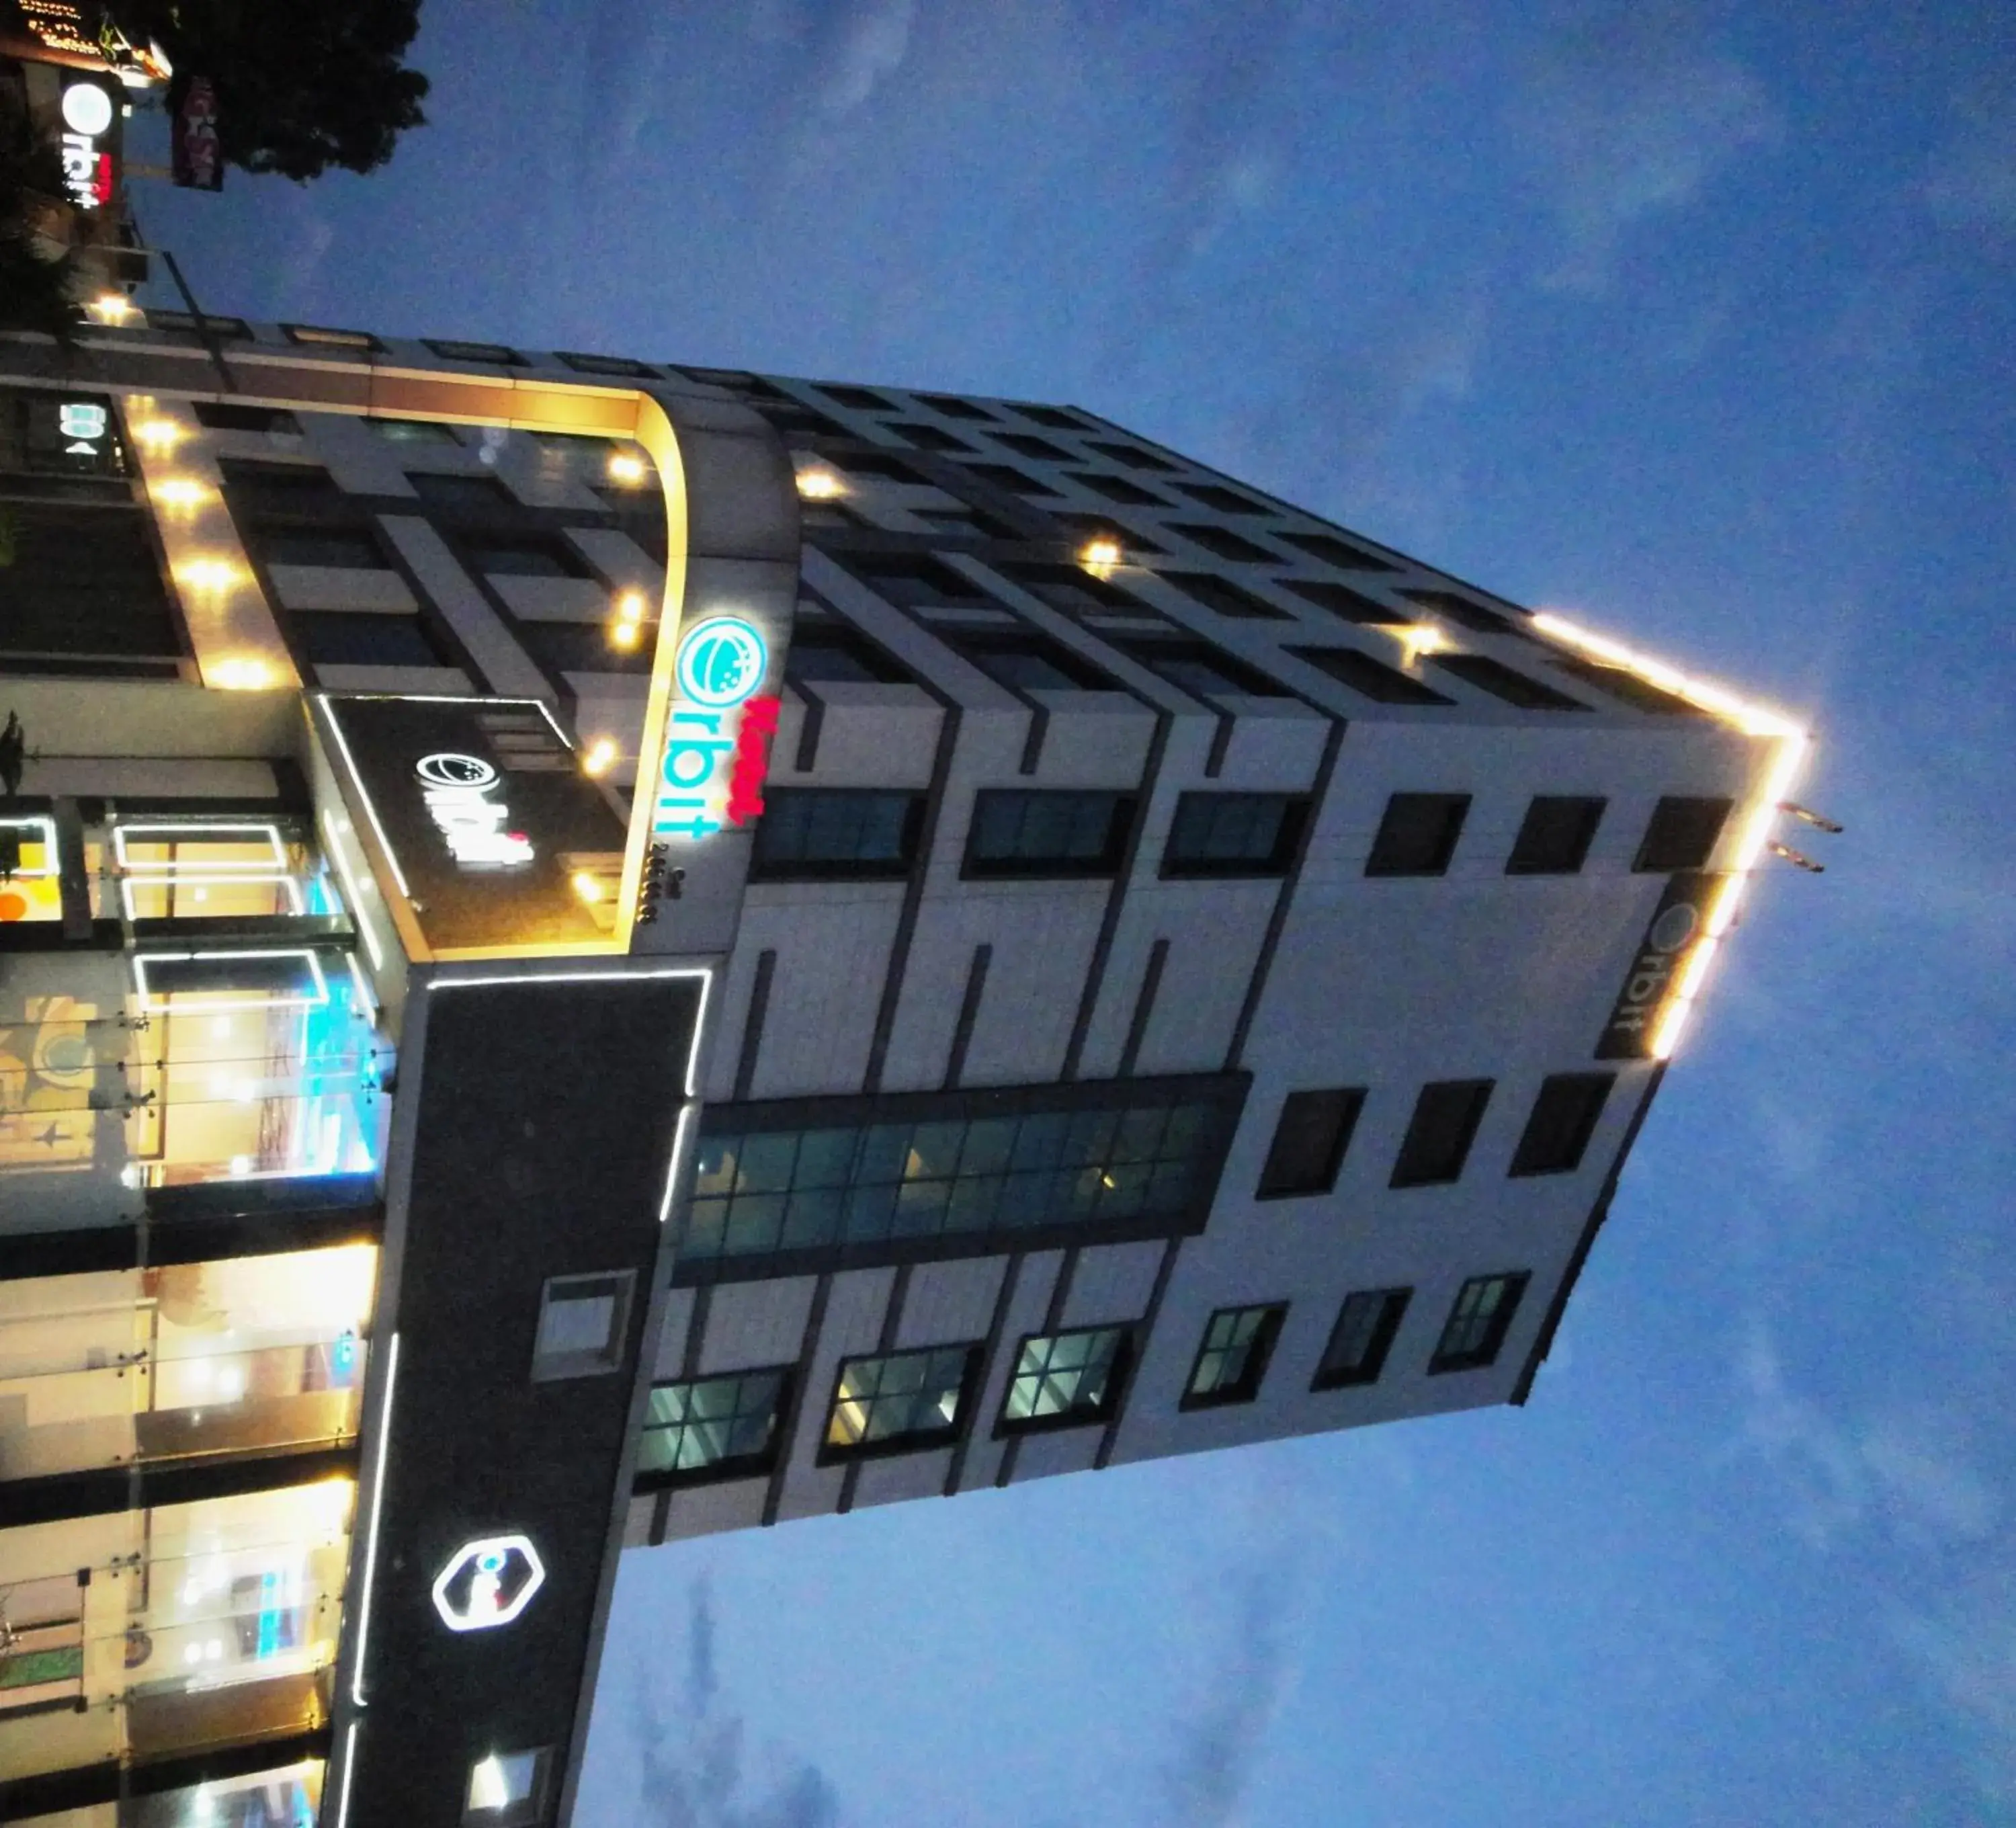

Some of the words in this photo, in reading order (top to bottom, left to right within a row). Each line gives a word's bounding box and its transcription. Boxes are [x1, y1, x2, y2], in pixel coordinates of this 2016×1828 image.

[62, 83, 112, 209] Orbit
[653, 616, 767, 840] Orbit
[1614, 902, 1699, 1032] Orbit
